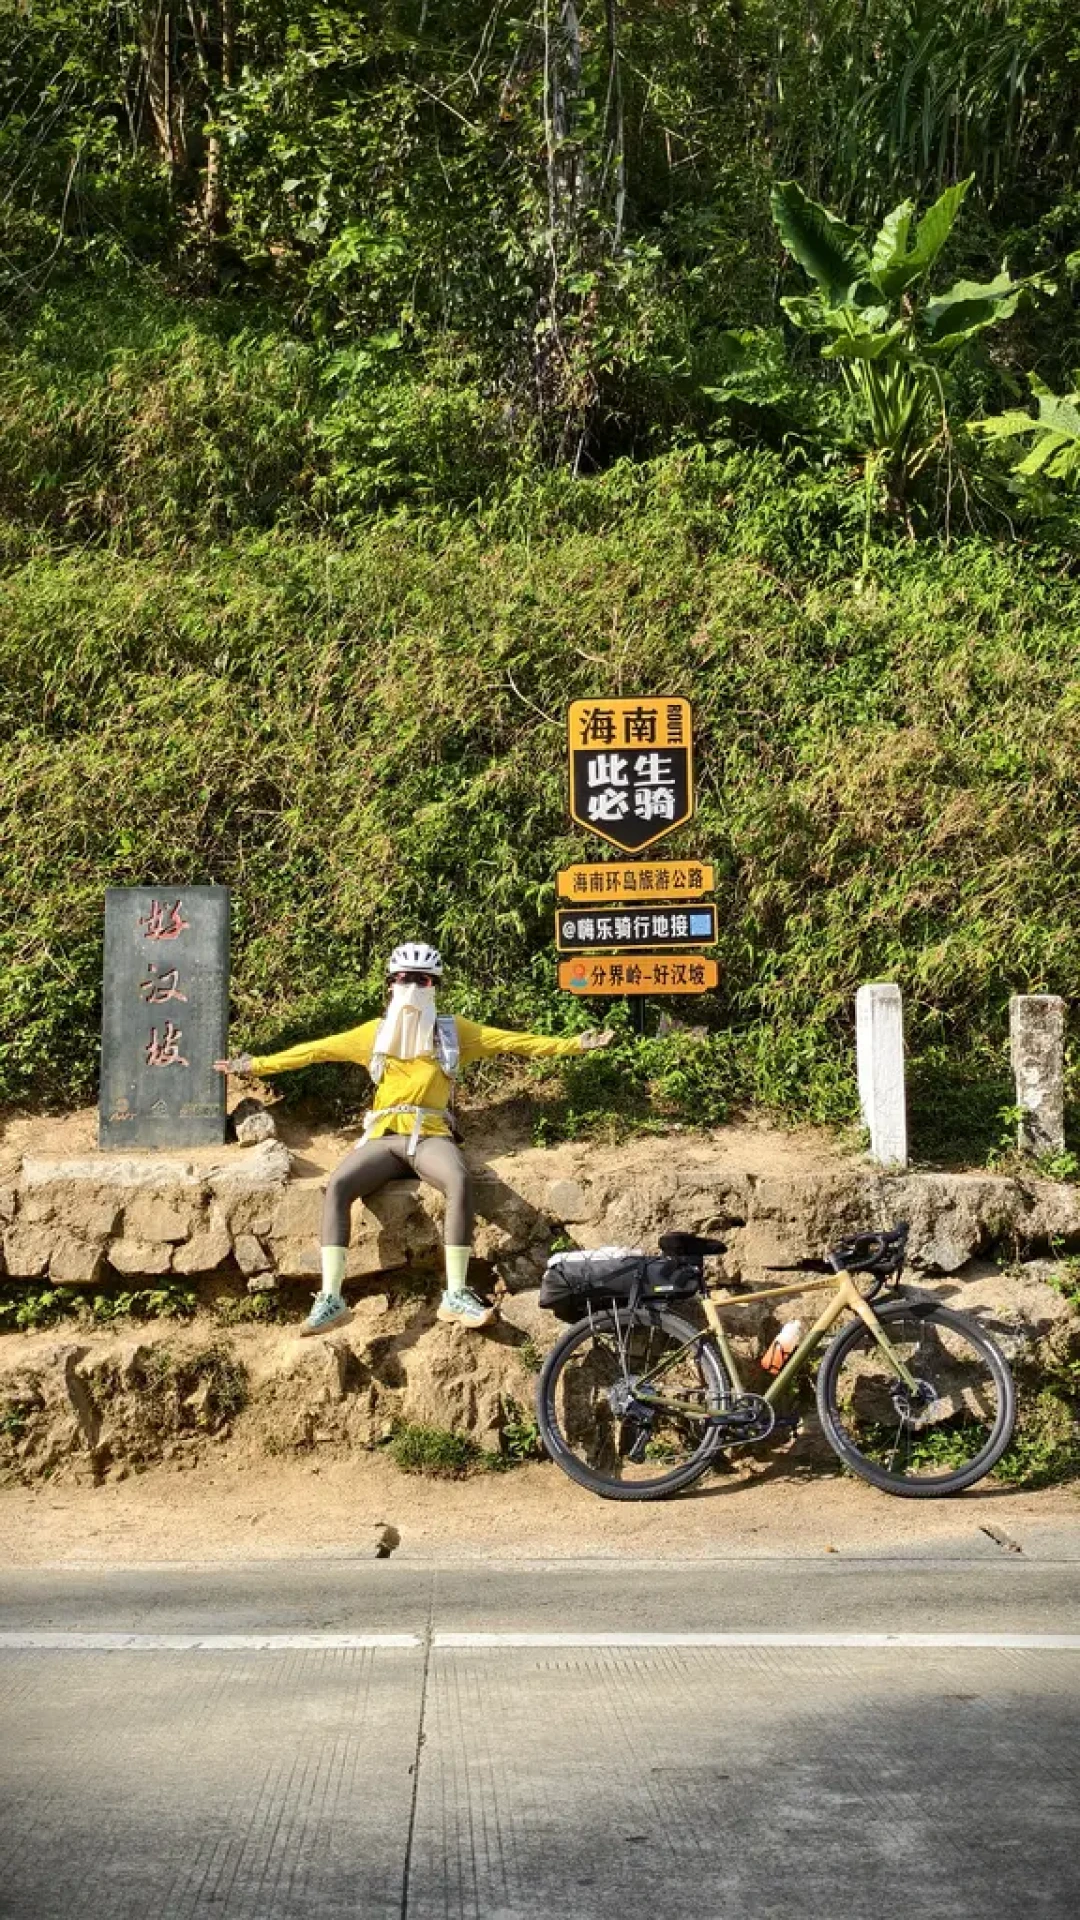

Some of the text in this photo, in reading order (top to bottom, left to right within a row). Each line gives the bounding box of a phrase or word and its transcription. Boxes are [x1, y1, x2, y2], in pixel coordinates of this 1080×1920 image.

[579, 706, 658, 744] 海南
[667, 704, 682, 744] ROUTE
[587, 753, 676, 786] 此生
[587, 787, 676, 821] 必骑
[573, 868, 703, 893] 海南环岛旅游公路
[562, 914, 689, 941] @嗨乐骑行地接
[139, 899, 189, 1067] 好汉坡
